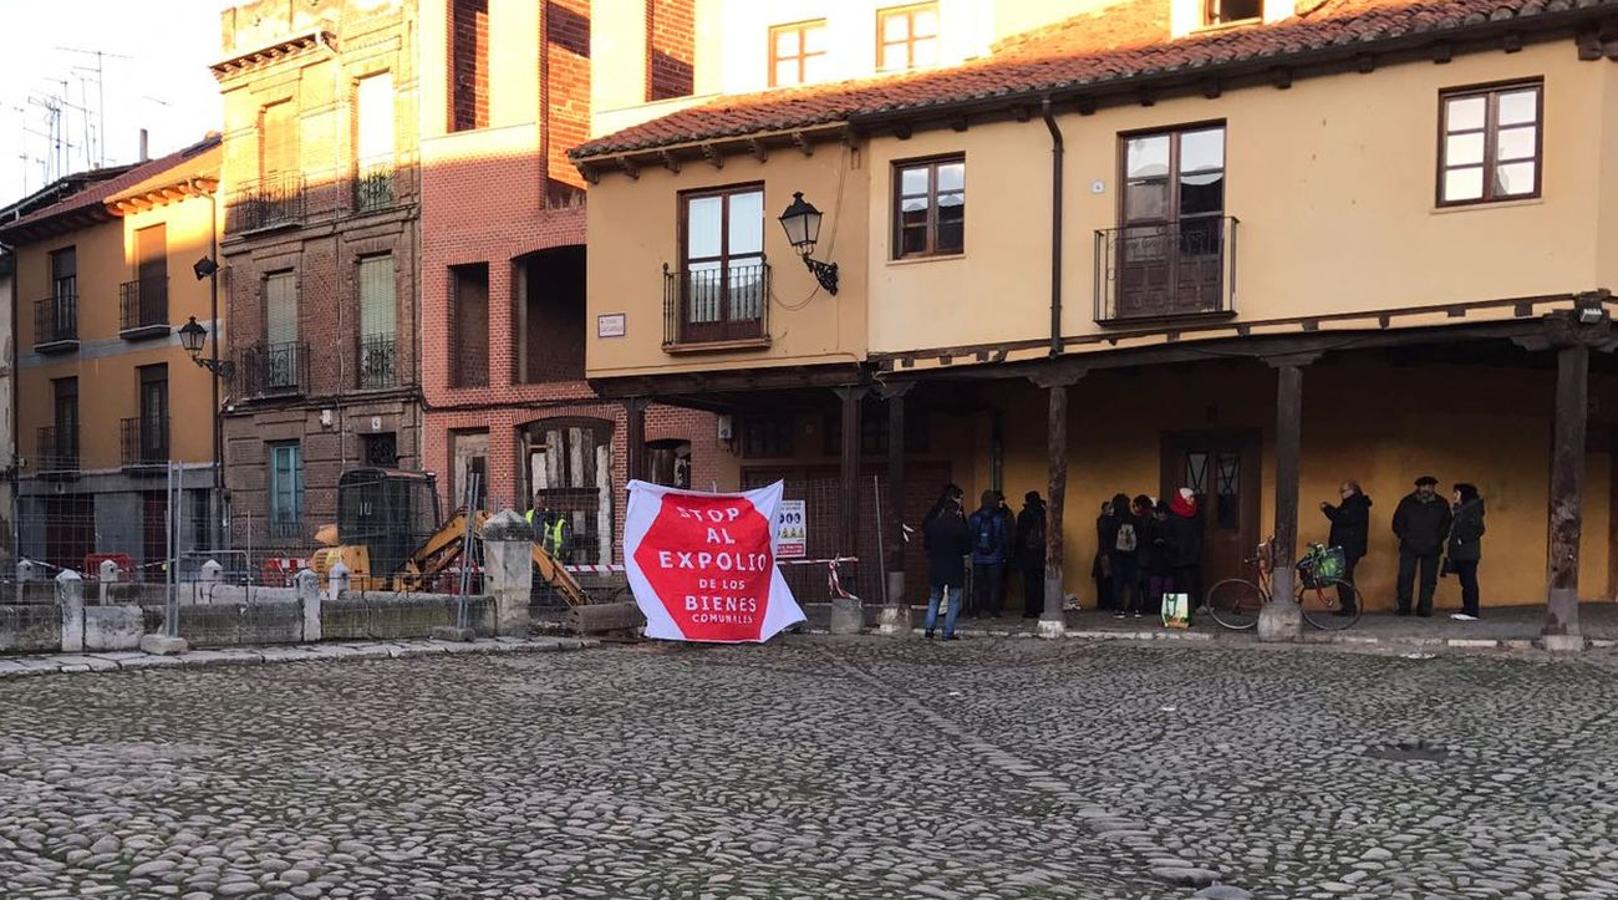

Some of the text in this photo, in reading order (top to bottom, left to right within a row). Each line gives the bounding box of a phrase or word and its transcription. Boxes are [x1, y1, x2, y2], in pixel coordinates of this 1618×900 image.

[676, 507, 740, 523] STOP
[706, 527, 736, 545] AL
[658, 551, 768, 572] EXPOLIO
[699, 578, 746, 590] DE LOS
[684, 595, 757, 613] BIENES
[691, 613, 753, 624] COMUNALES
